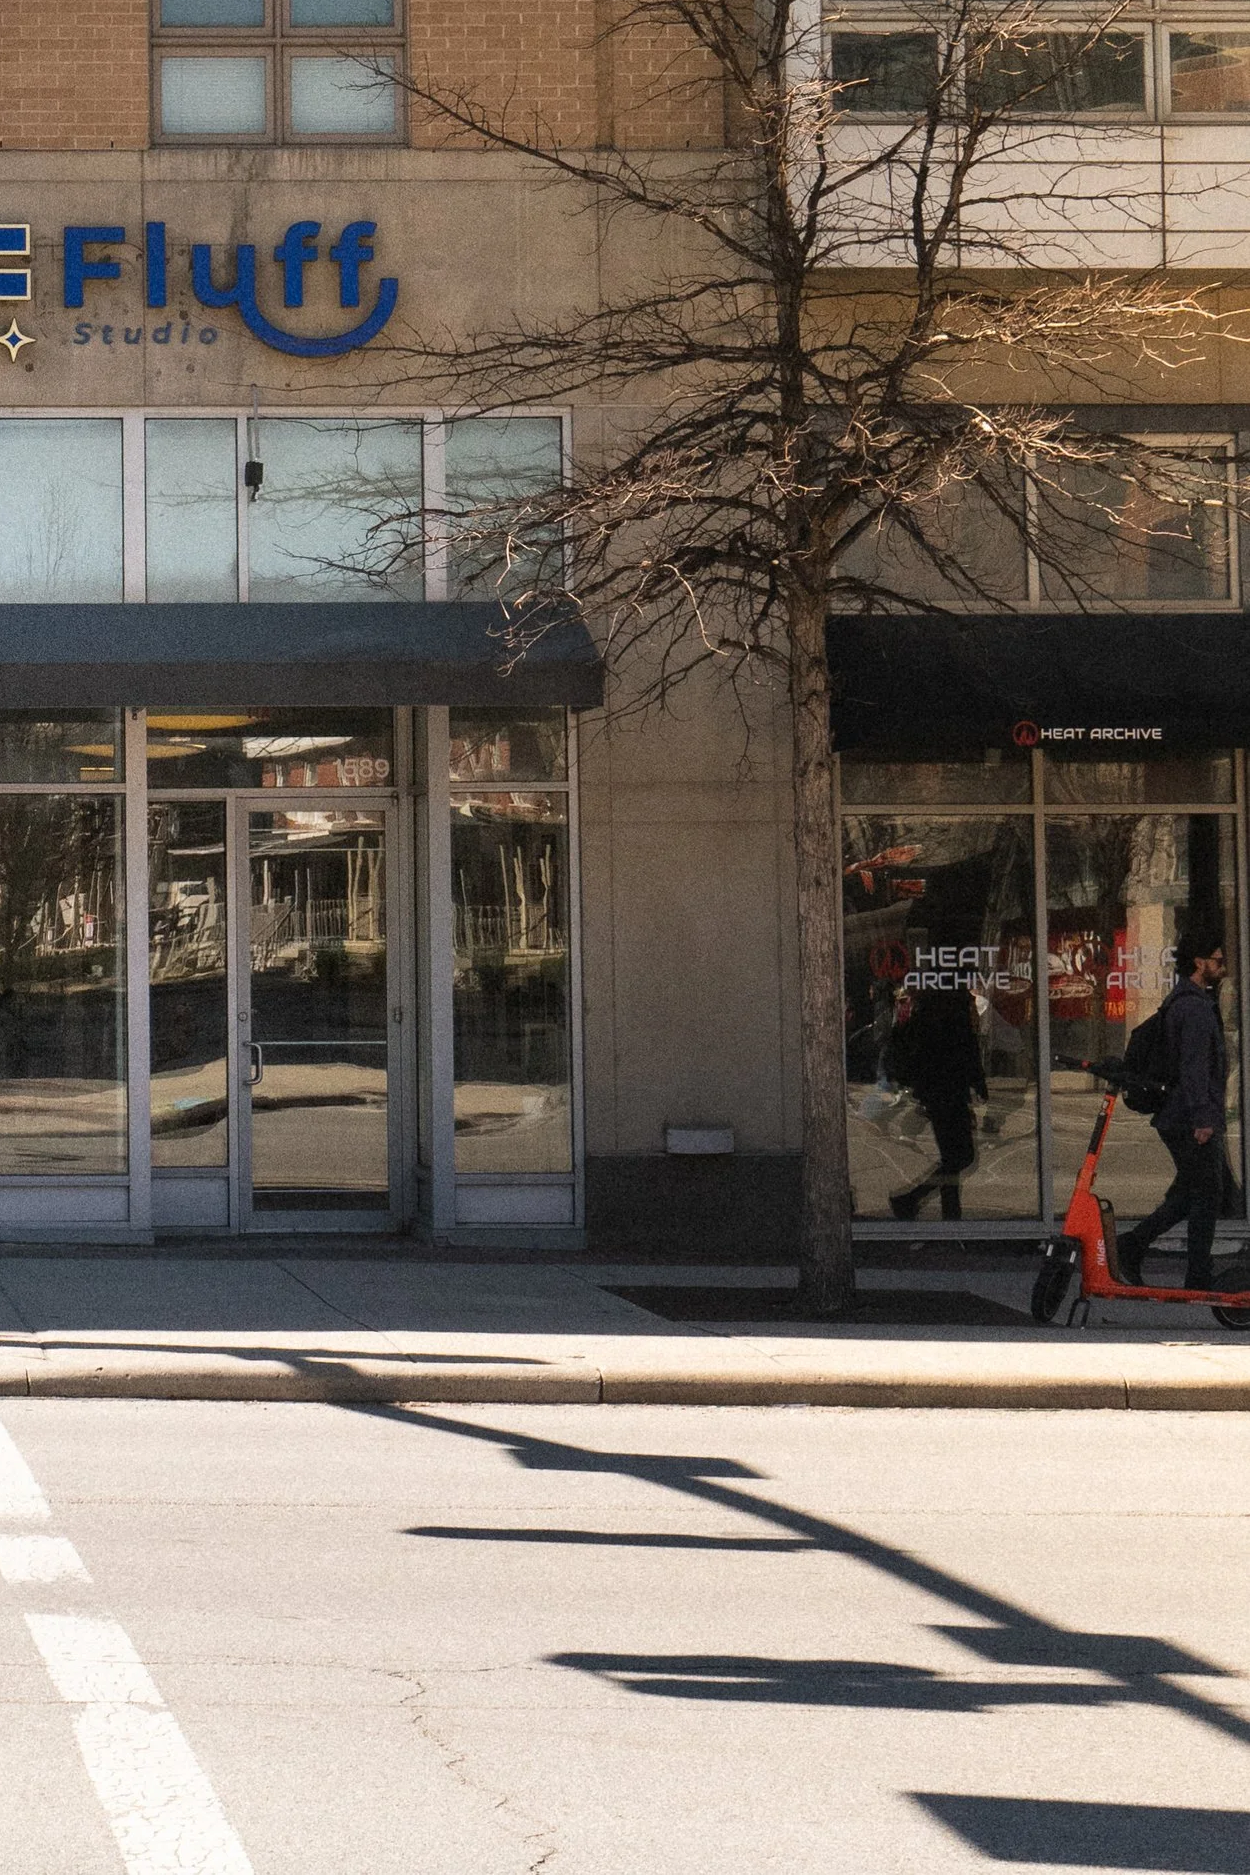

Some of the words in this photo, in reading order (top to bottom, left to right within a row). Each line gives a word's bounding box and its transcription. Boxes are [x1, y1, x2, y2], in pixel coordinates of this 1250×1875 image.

[63, 220, 399, 358] Fluff
[73, 320, 219, 346] Studio
[1040, 727, 1086, 740] HEAT
[1090, 727, 1163, 740] ARCHIVE
[332, 757, 390, 779] 1589
[915, 946, 1000, 967] HEAT
[903, 971, 1011, 990] ARCHIVE
[1096, 1239, 1106, 1266] SPIN
